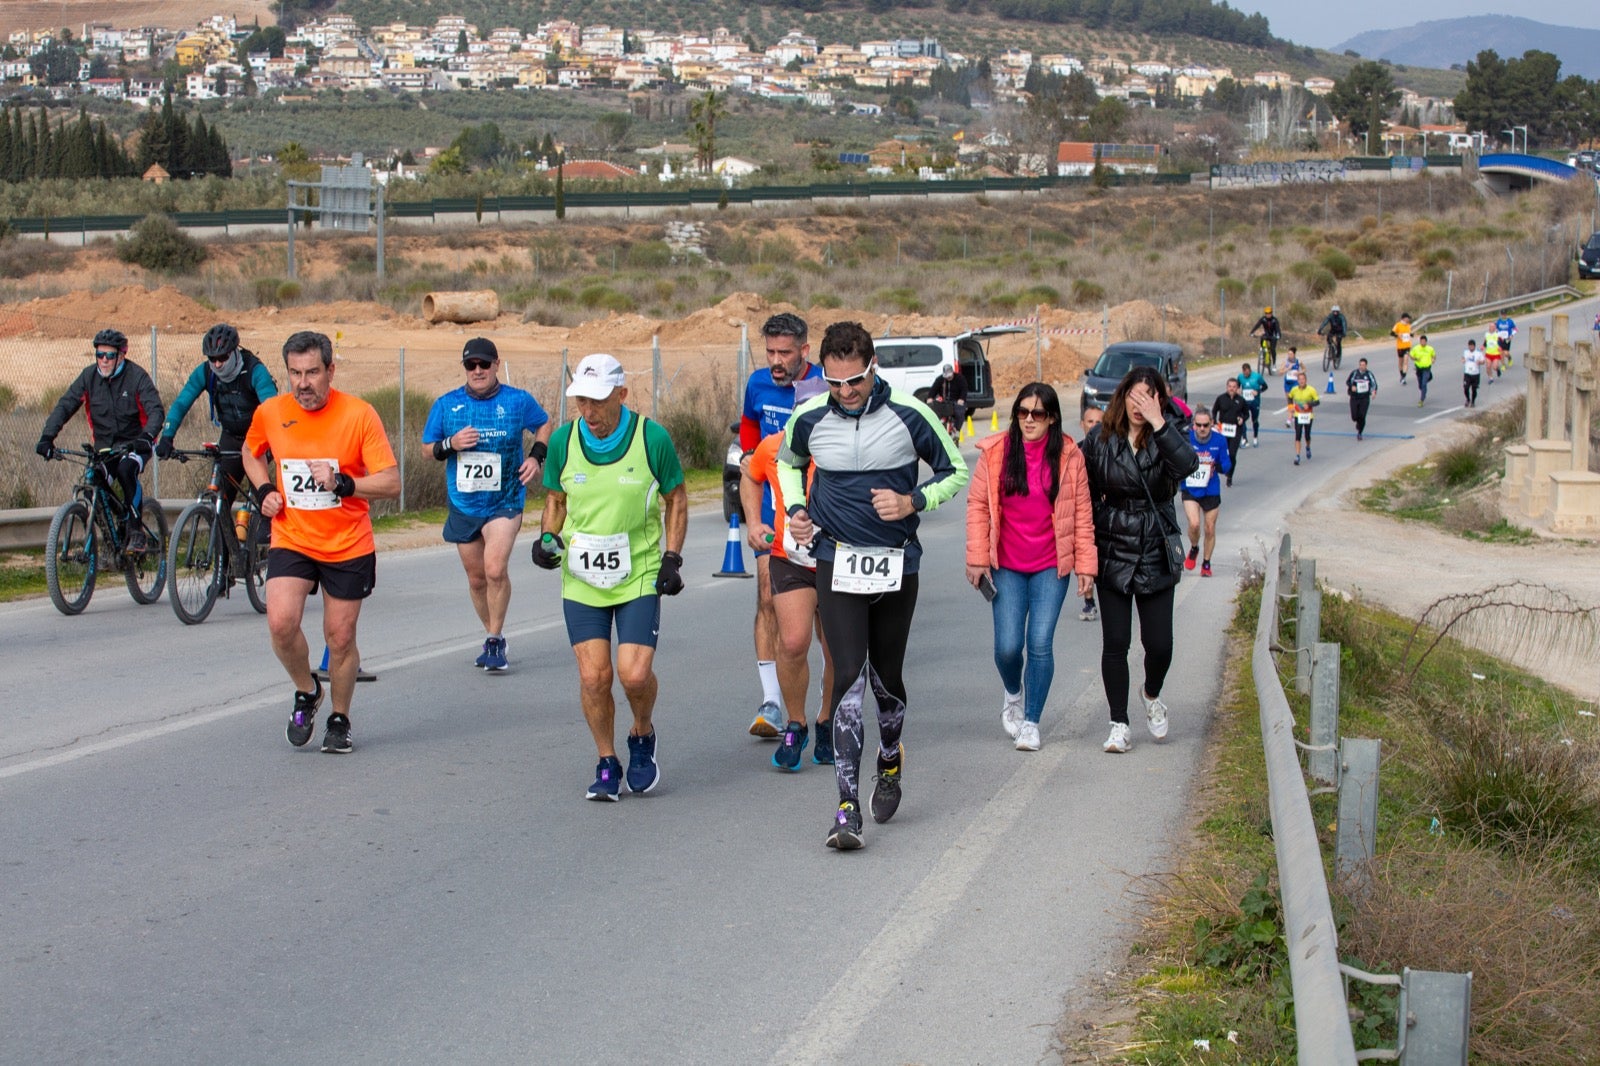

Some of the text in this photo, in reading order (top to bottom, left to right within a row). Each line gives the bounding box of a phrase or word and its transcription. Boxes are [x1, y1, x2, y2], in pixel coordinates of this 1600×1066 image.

[485, 430, 507, 438] PAZITO
[464, 464, 494, 479] 720
[1191, 471, 1206, 480] 487
[580, 551, 620, 570] 145
[846, 553, 890, 577] 104
